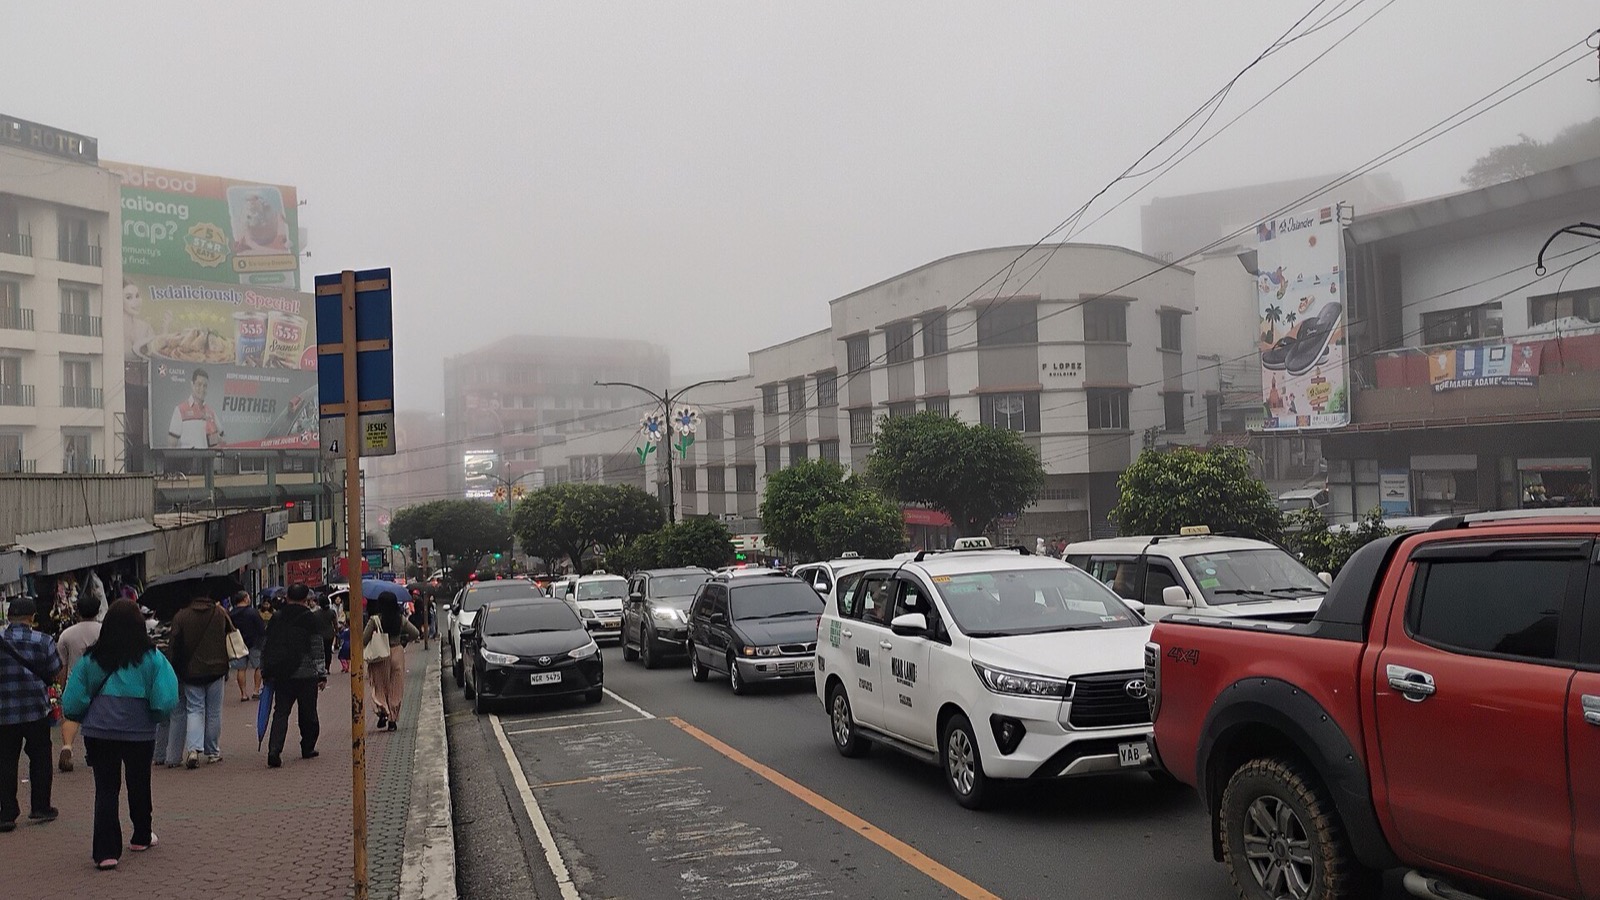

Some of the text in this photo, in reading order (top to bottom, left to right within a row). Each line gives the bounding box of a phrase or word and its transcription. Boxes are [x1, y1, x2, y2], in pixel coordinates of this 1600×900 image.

[206, 228, 213, 239] 5
[149, 285, 301, 313] Isdaliciously Special!
[241, 323, 263, 335] 555
[275, 324, 299, 341] 555
[1053, 362, 1082, 370] LOPEZ
[222, 396, 277, 413] FURTHER
[367, 422, 388, 432] JESUS
[961, 540, 987, 548] TAXI
[1120, 747, 1140, 762] YAB
